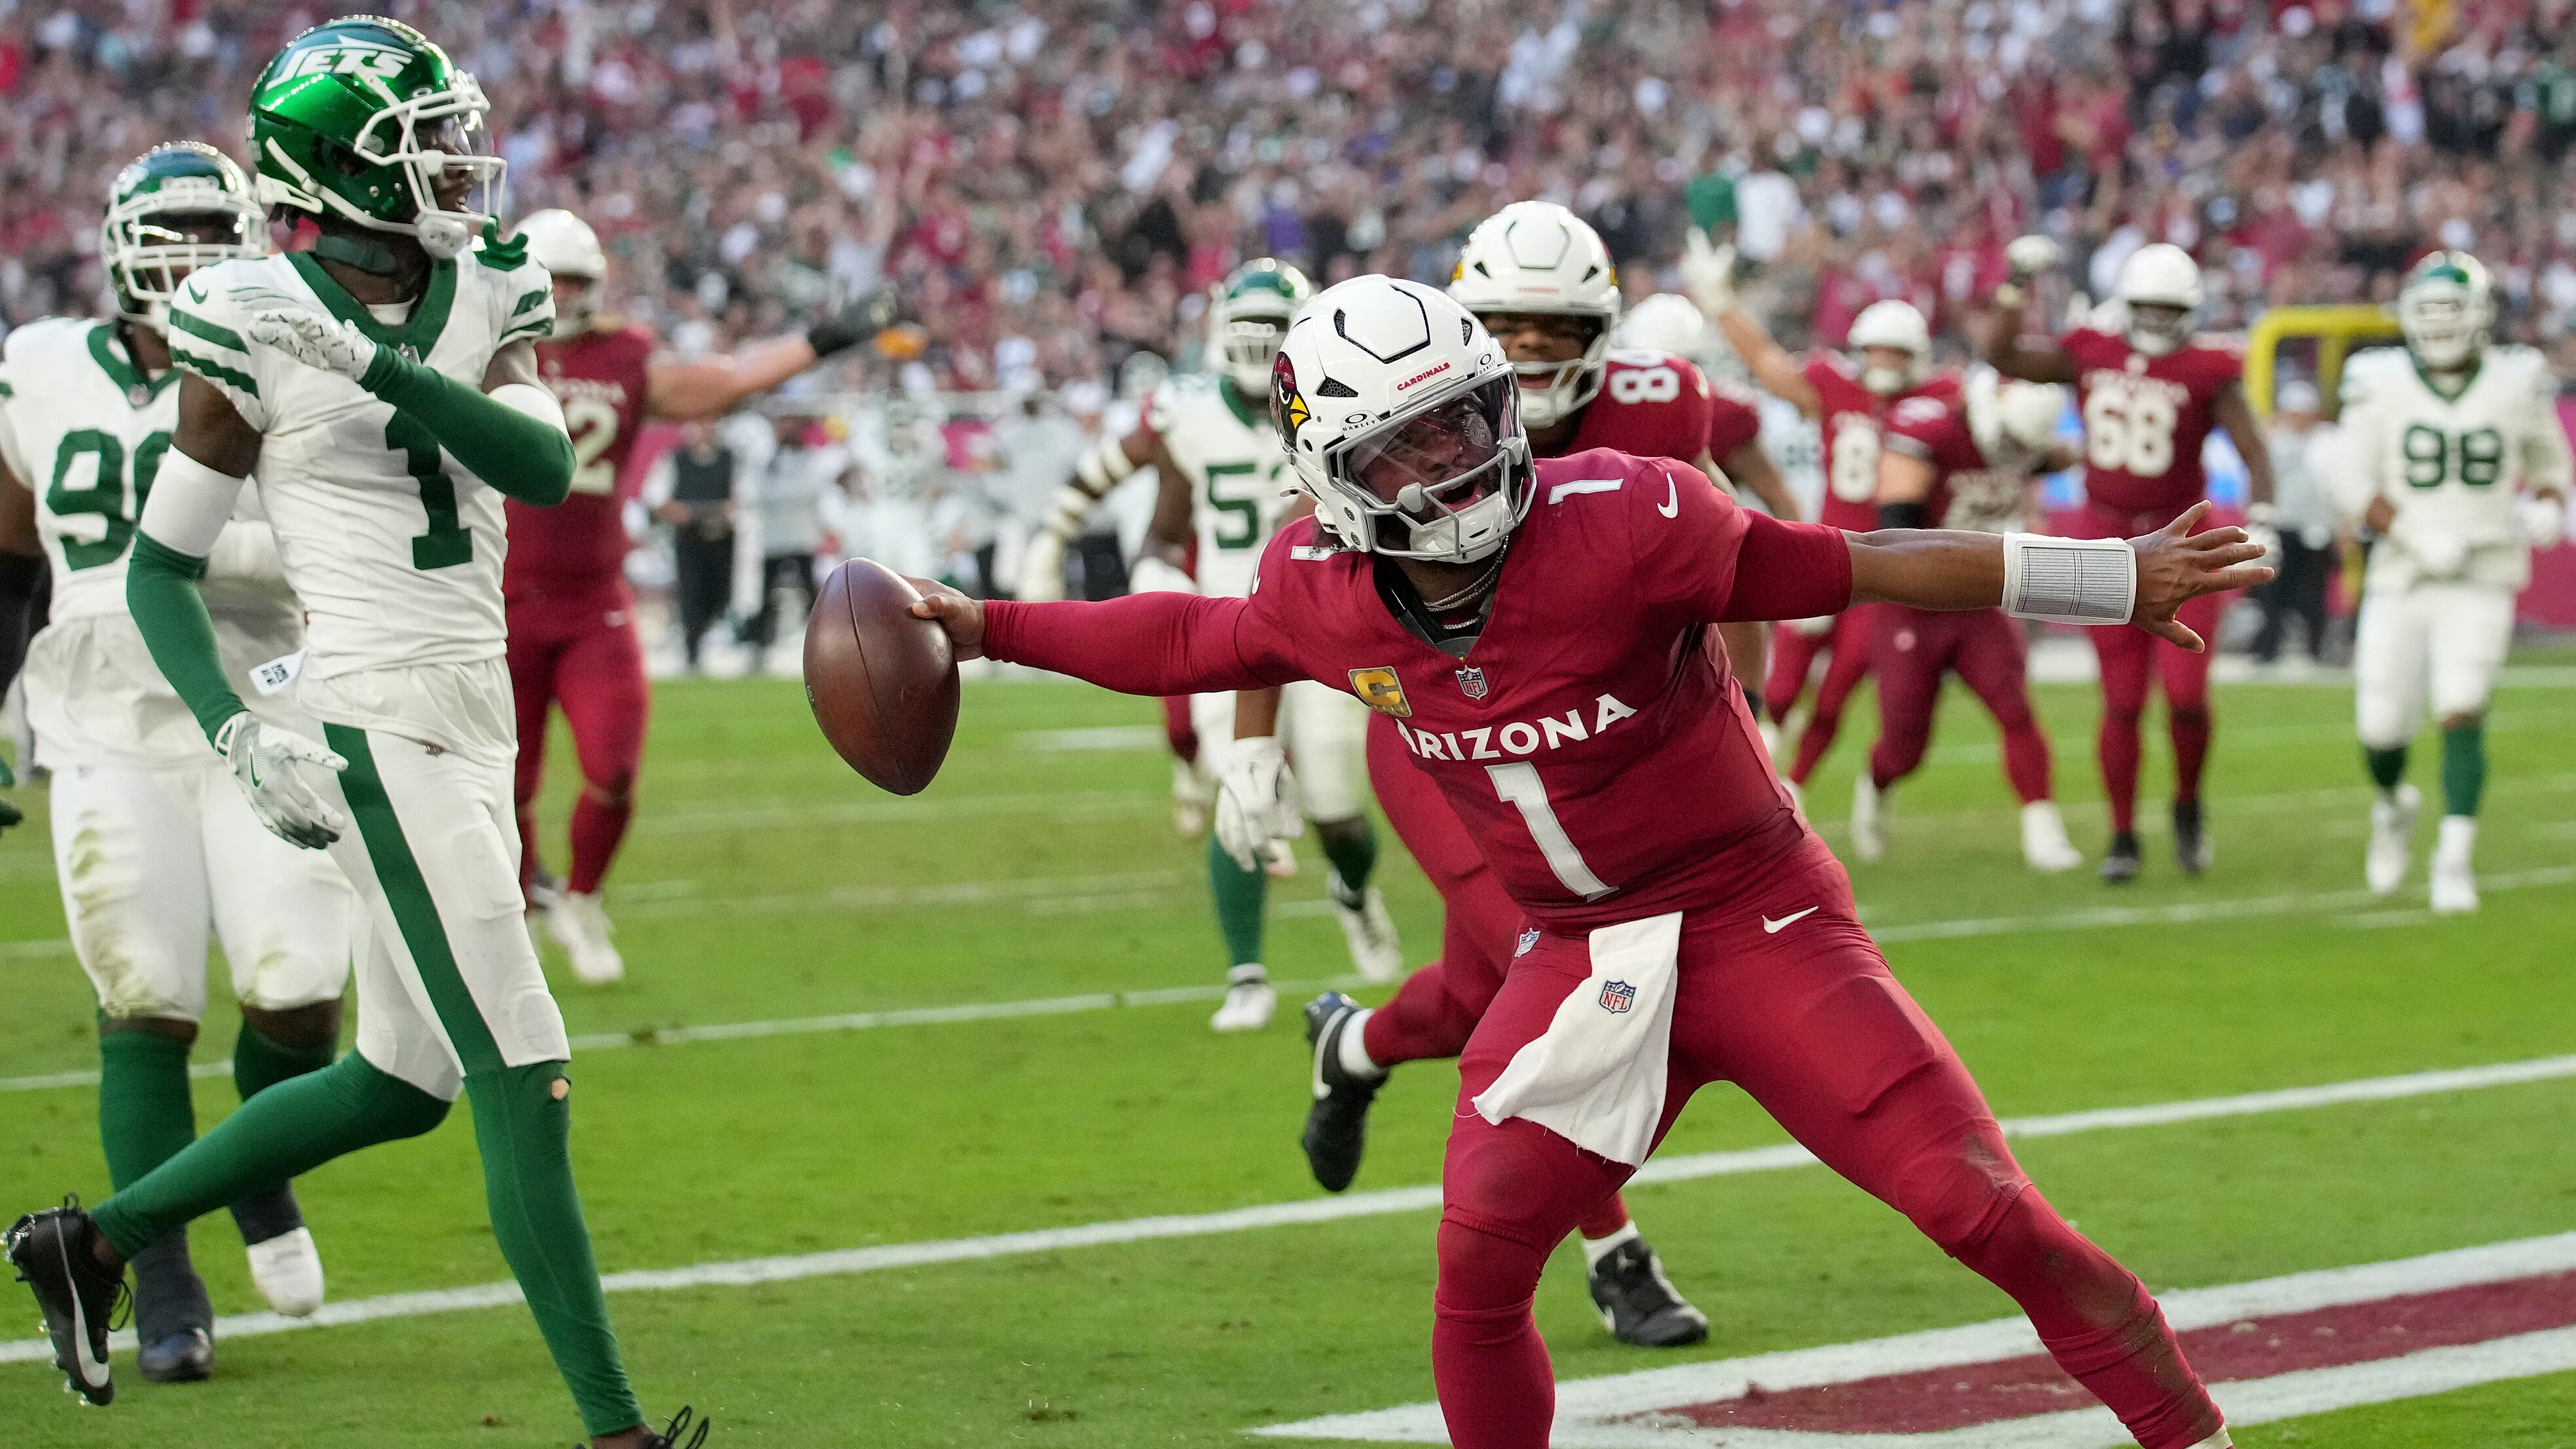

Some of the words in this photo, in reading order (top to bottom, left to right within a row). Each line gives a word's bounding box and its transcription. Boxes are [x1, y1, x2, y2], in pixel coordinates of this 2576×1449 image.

[265, 35, 415, 91] JETS
[1396, 362, 1451, 391] CARDINALS
[1608, 354, 1680, 405] 8
[566, 399, 618, 496] 2
[1343, 420, 1375, 431] OAKLEY
[2403, 424, 2505, 488] 98
[385, 407, 473, 571] 1
[1205, 462, 1284, 549] 5
[1395, 693, 1637, 761] ARIZONA
[1484, 760, 1619, 903] 1
[1602, 991, 1628, 1010] NFL
